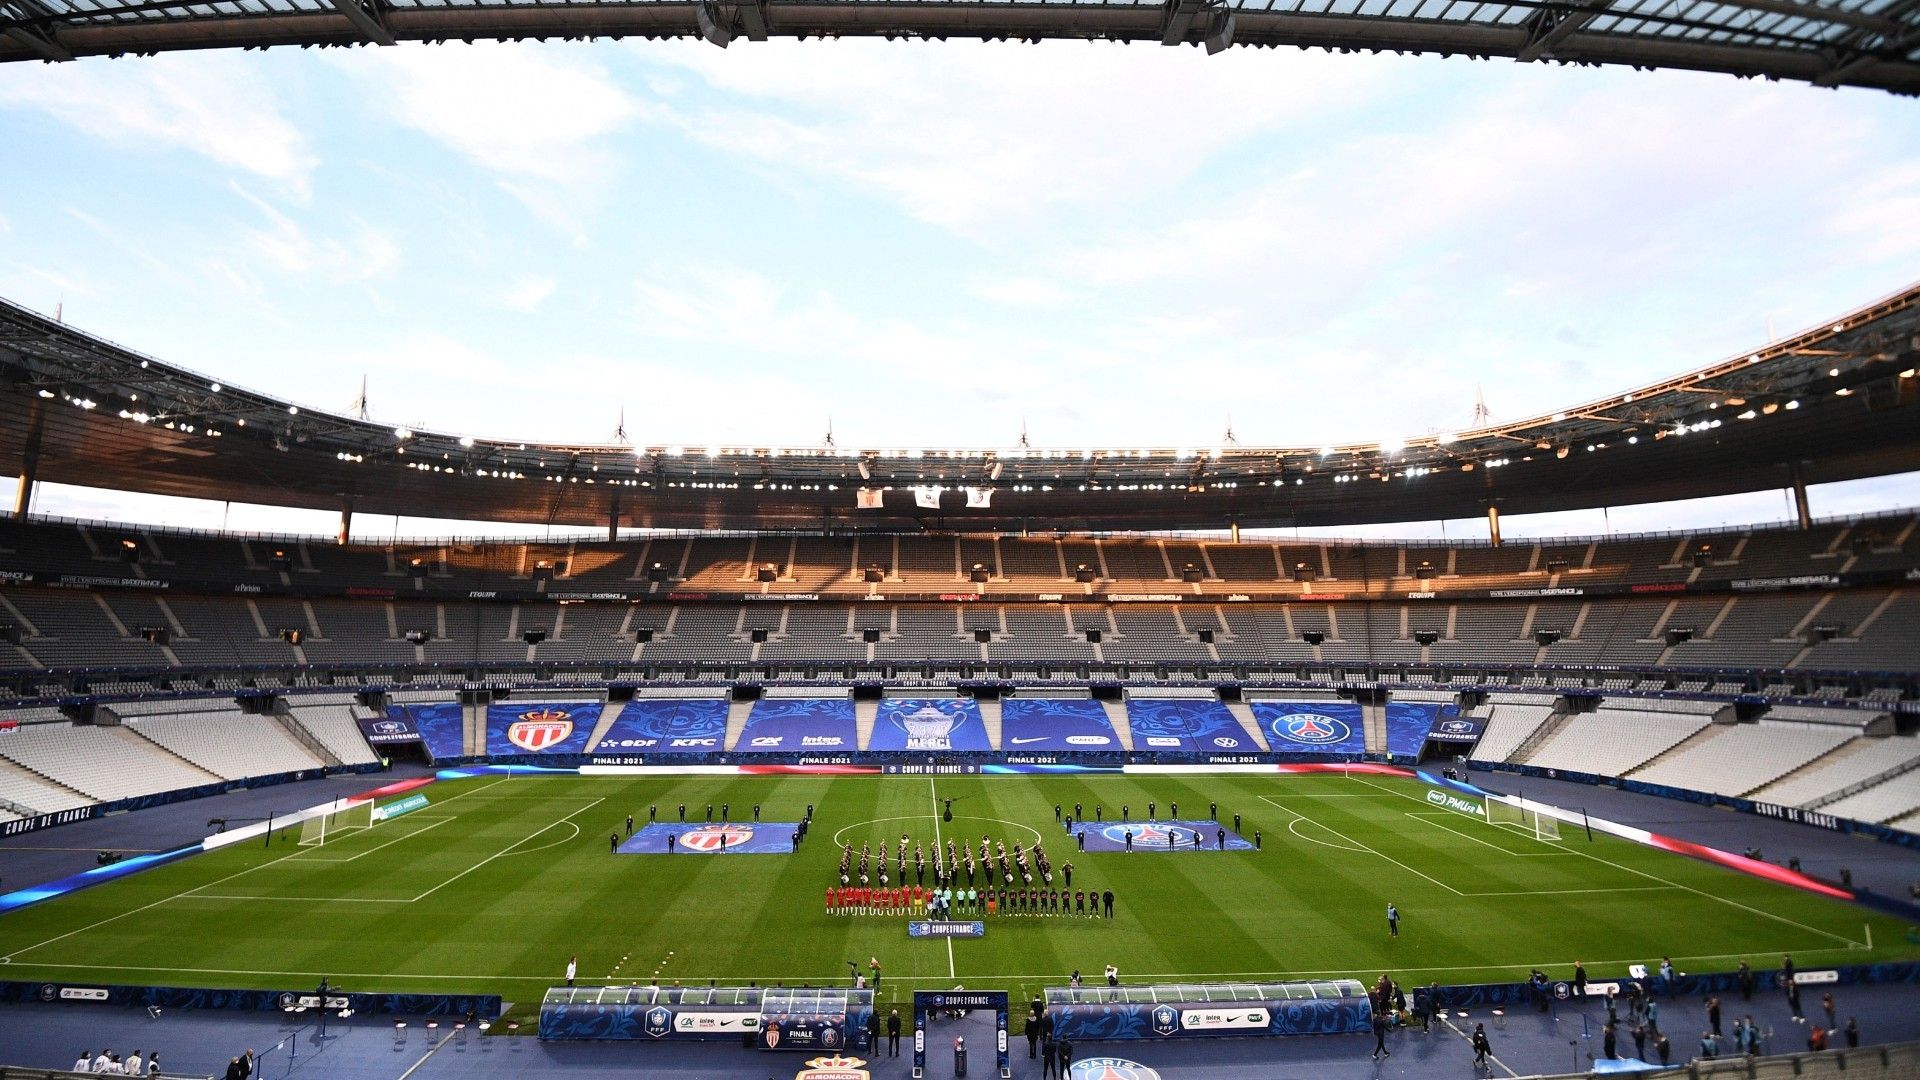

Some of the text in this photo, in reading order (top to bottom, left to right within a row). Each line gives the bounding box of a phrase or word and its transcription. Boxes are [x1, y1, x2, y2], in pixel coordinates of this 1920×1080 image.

[1283, 714, 1332, 724] PARIS
[908, 738, 951, 748] MERCI
[5, 807, 91, 834] COUPE DE FRANCE
[1755, 802, 1837, 829] COUPE DE FRANCE
[932, 925, 949, 933] COUPE
[953, 925, 974, 933] FRANCE
[1078, 1060, 1136, 1070] PARIS
